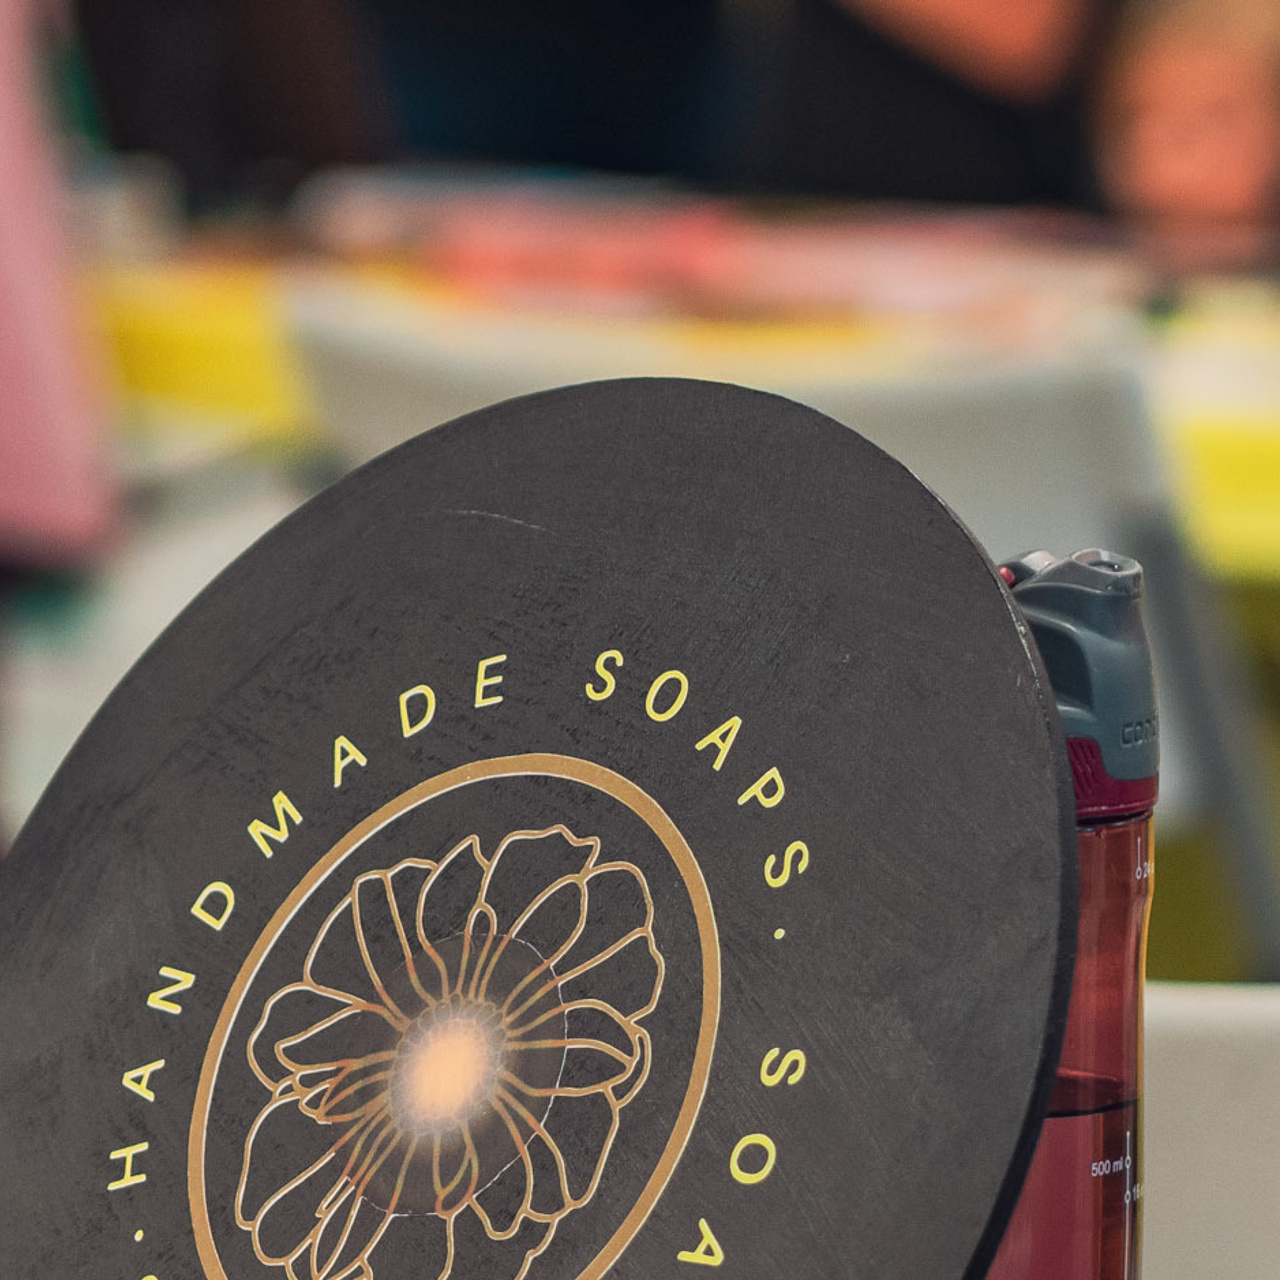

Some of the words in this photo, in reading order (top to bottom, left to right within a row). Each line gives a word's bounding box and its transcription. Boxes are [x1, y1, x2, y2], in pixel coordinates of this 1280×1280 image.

[107, 653, 506, 1191] HANDMADE
[1091, 1159, 1111, 1177] 500
[1112, 1156, 1123, 1173] ml
